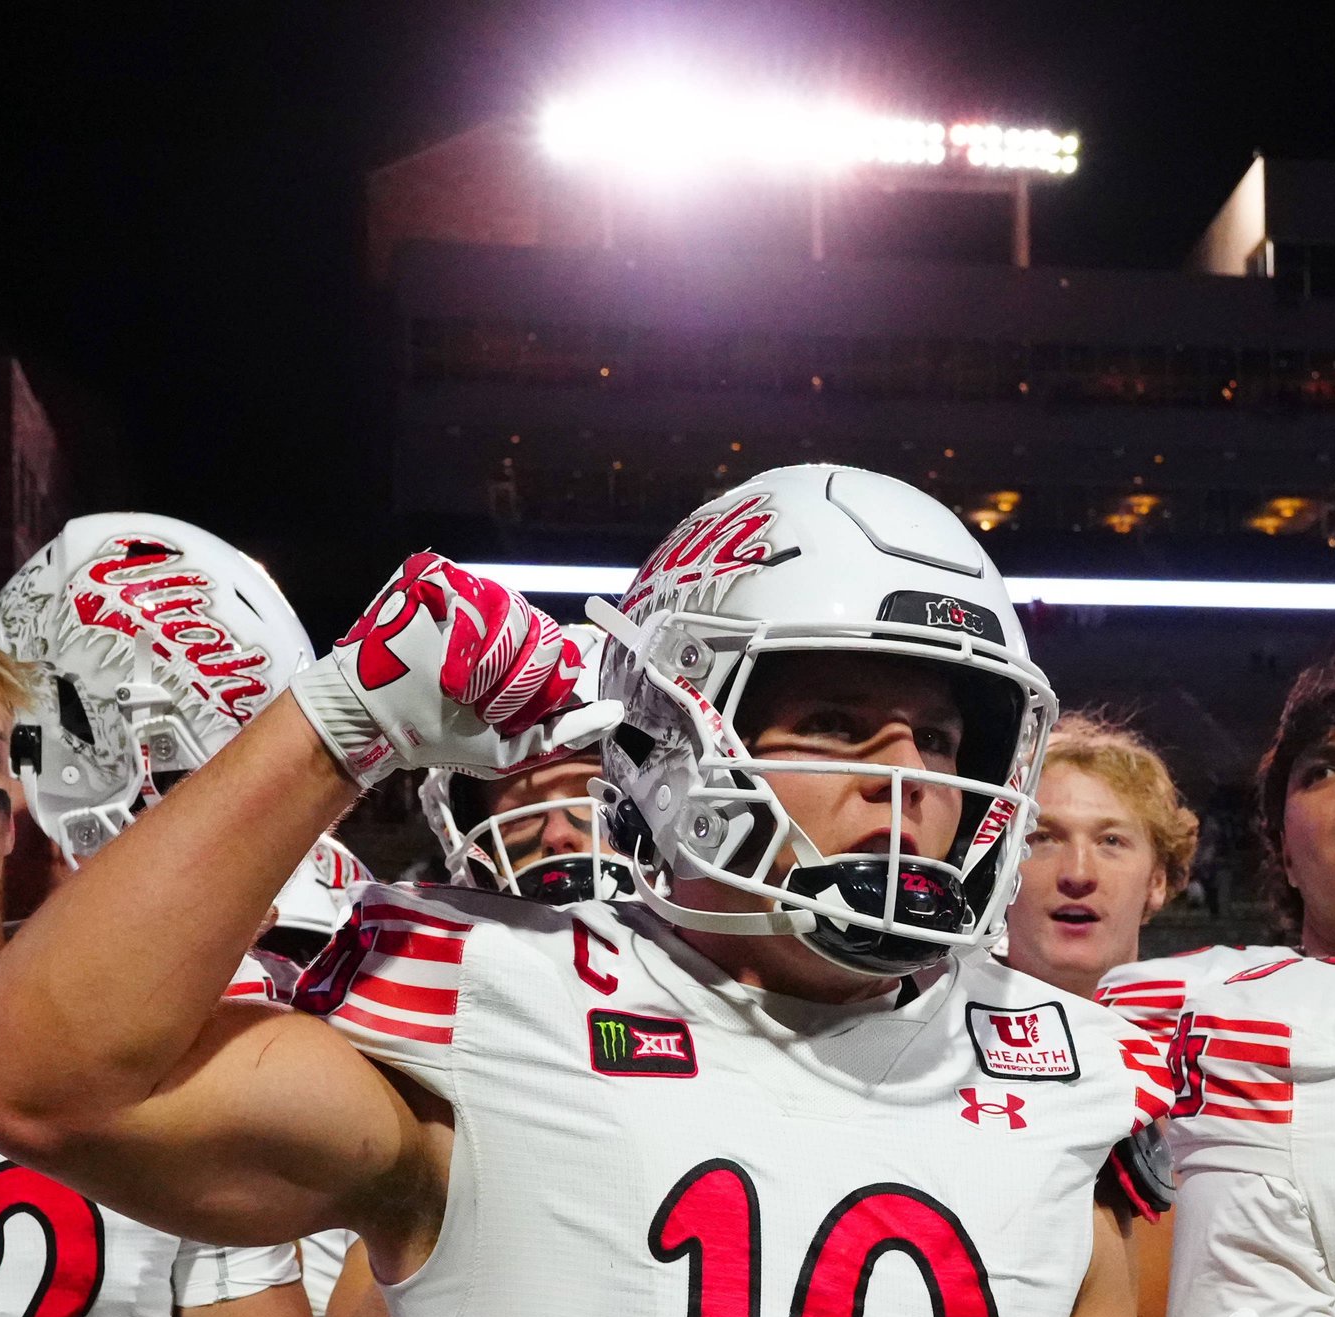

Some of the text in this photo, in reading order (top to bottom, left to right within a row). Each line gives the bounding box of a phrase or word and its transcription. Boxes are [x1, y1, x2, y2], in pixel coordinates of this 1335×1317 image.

[572, 918, 619, 995] C
[633, 1031, 685, 1057] XII
[986, 1049, 1067, 1065] HEALTH
[989, 1063, 1033, 1072] UNIVERSITY
